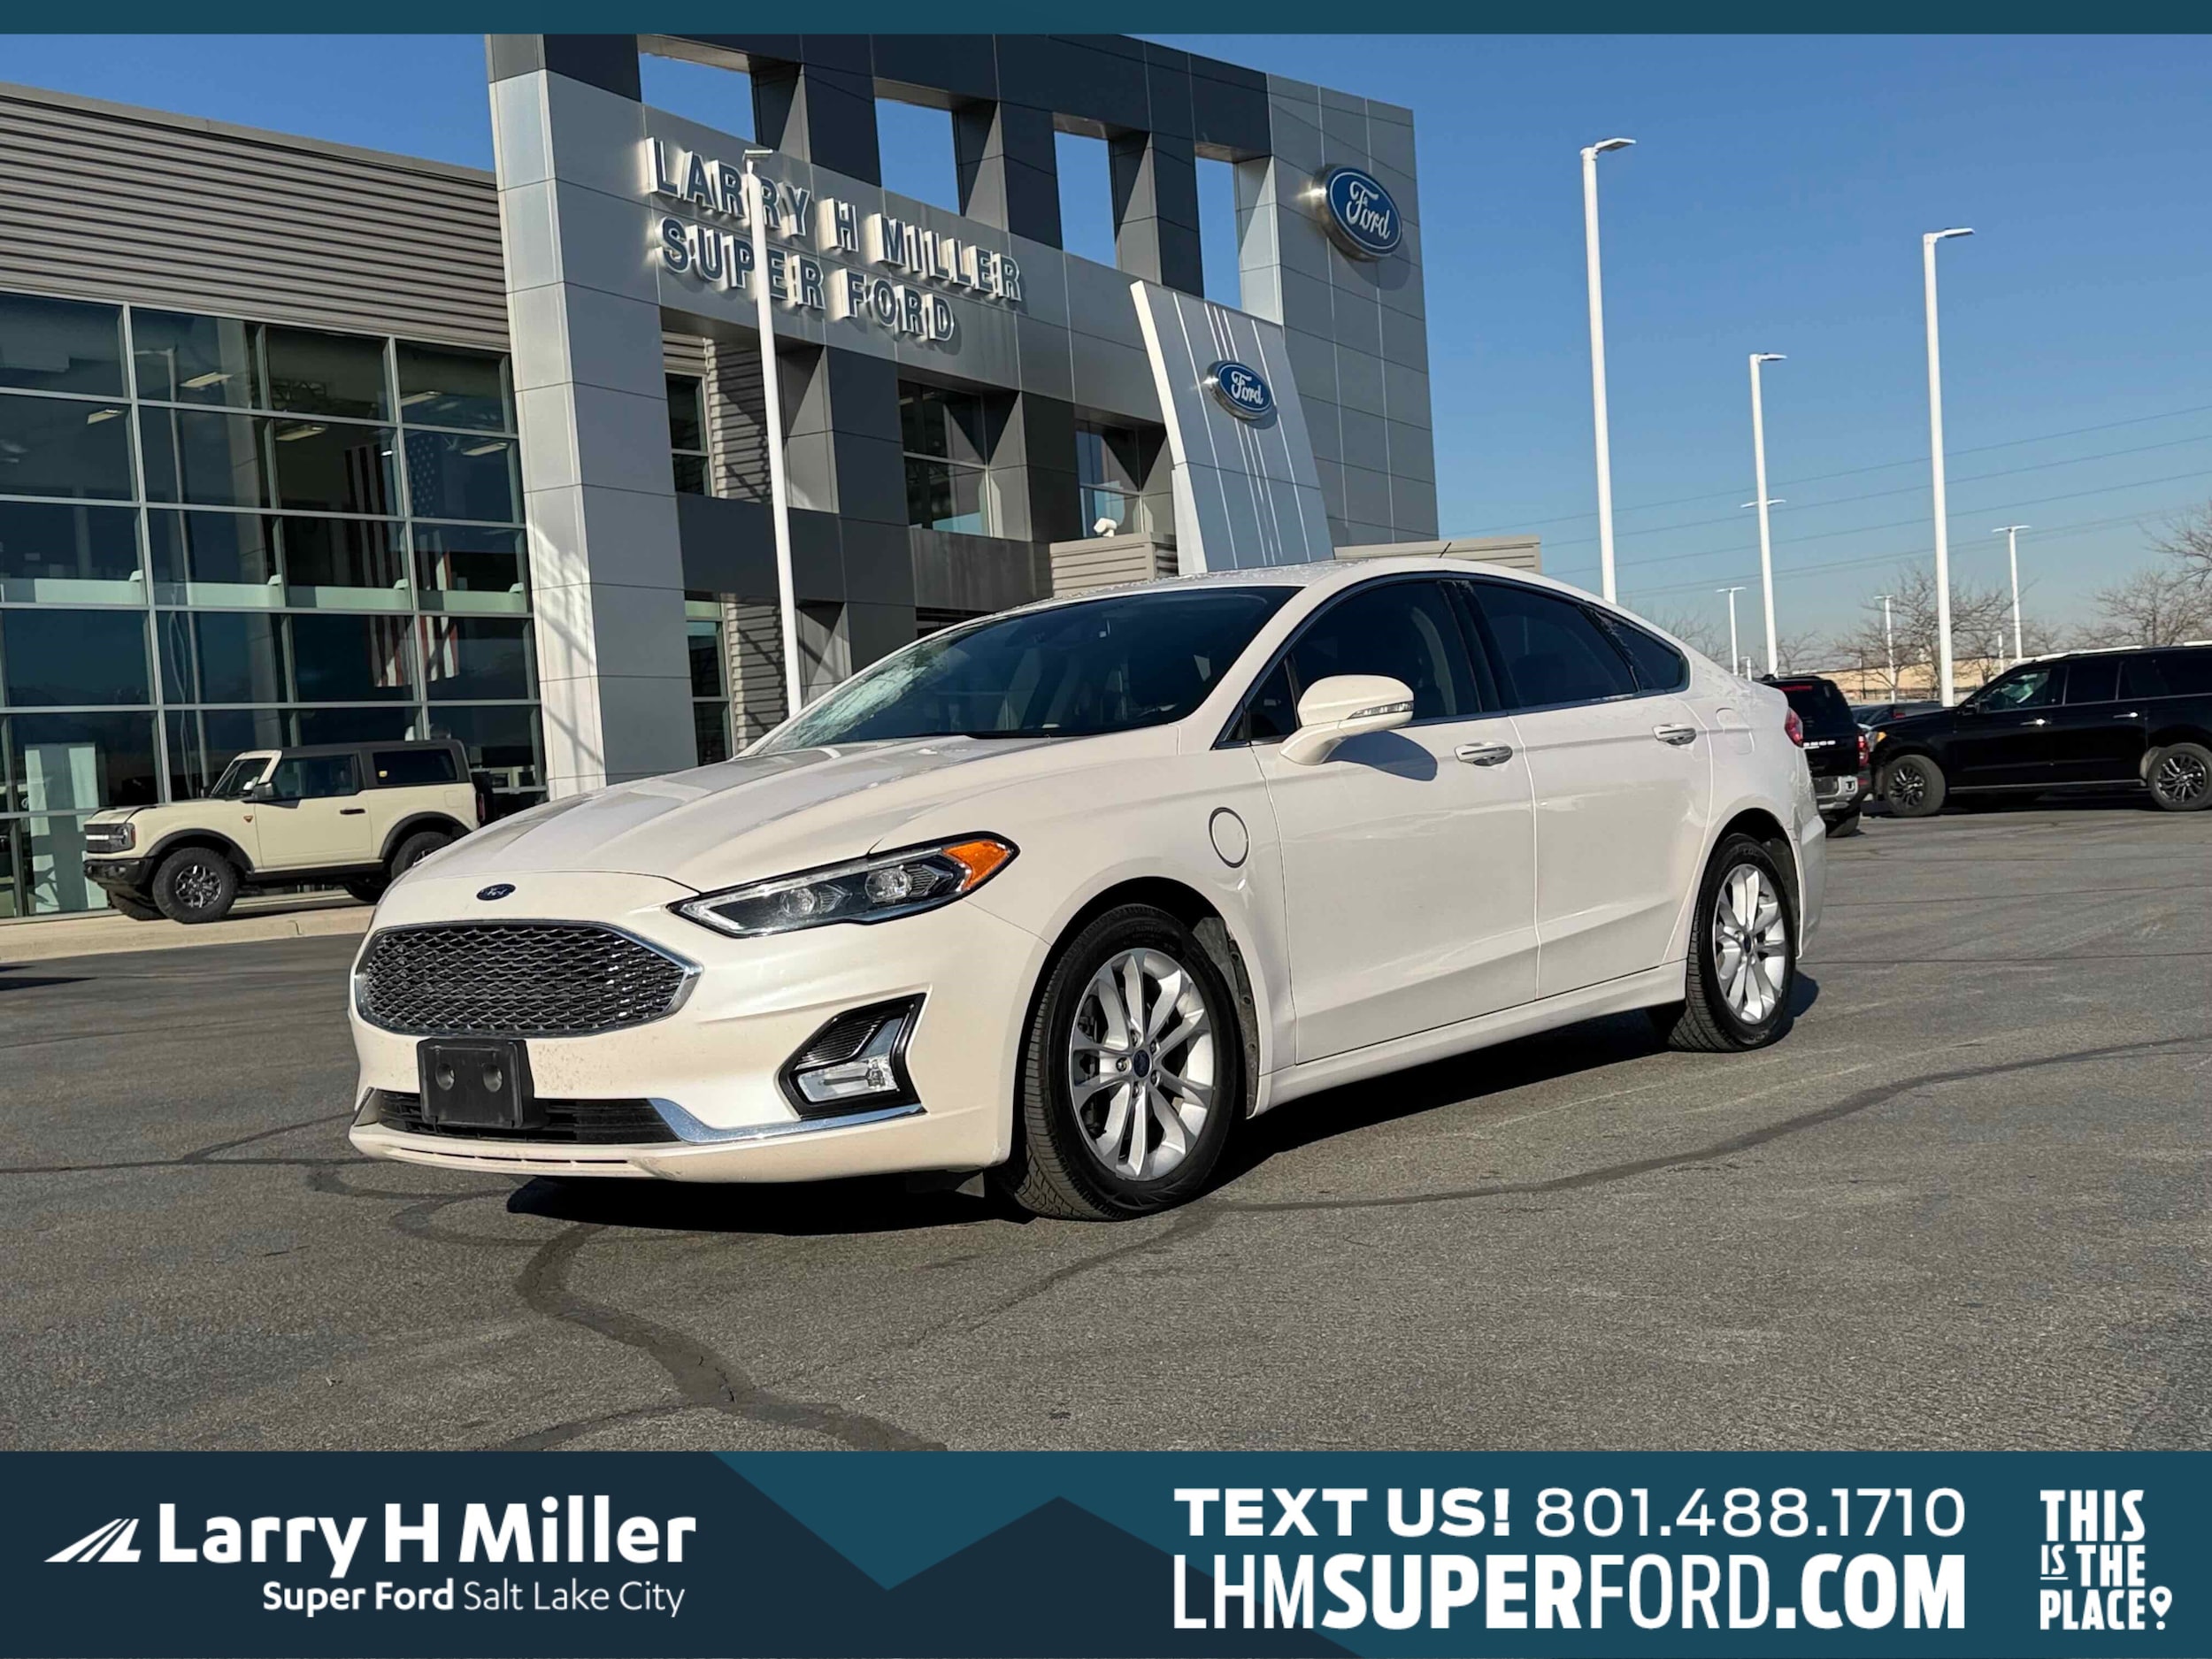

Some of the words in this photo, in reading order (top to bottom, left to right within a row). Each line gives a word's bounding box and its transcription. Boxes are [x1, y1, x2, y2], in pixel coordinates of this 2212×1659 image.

[645, 136, 810, 237] LARRY
[825, 198, 859, 253] H
[872, 212, 1023, 302] MILLER
[1345, 180, 1391, 241] Ford
[658, 215, 826, 311] SUPER
[839, 267, 956, 342] FORD
[1230, 370, 1264, 406] Ford
